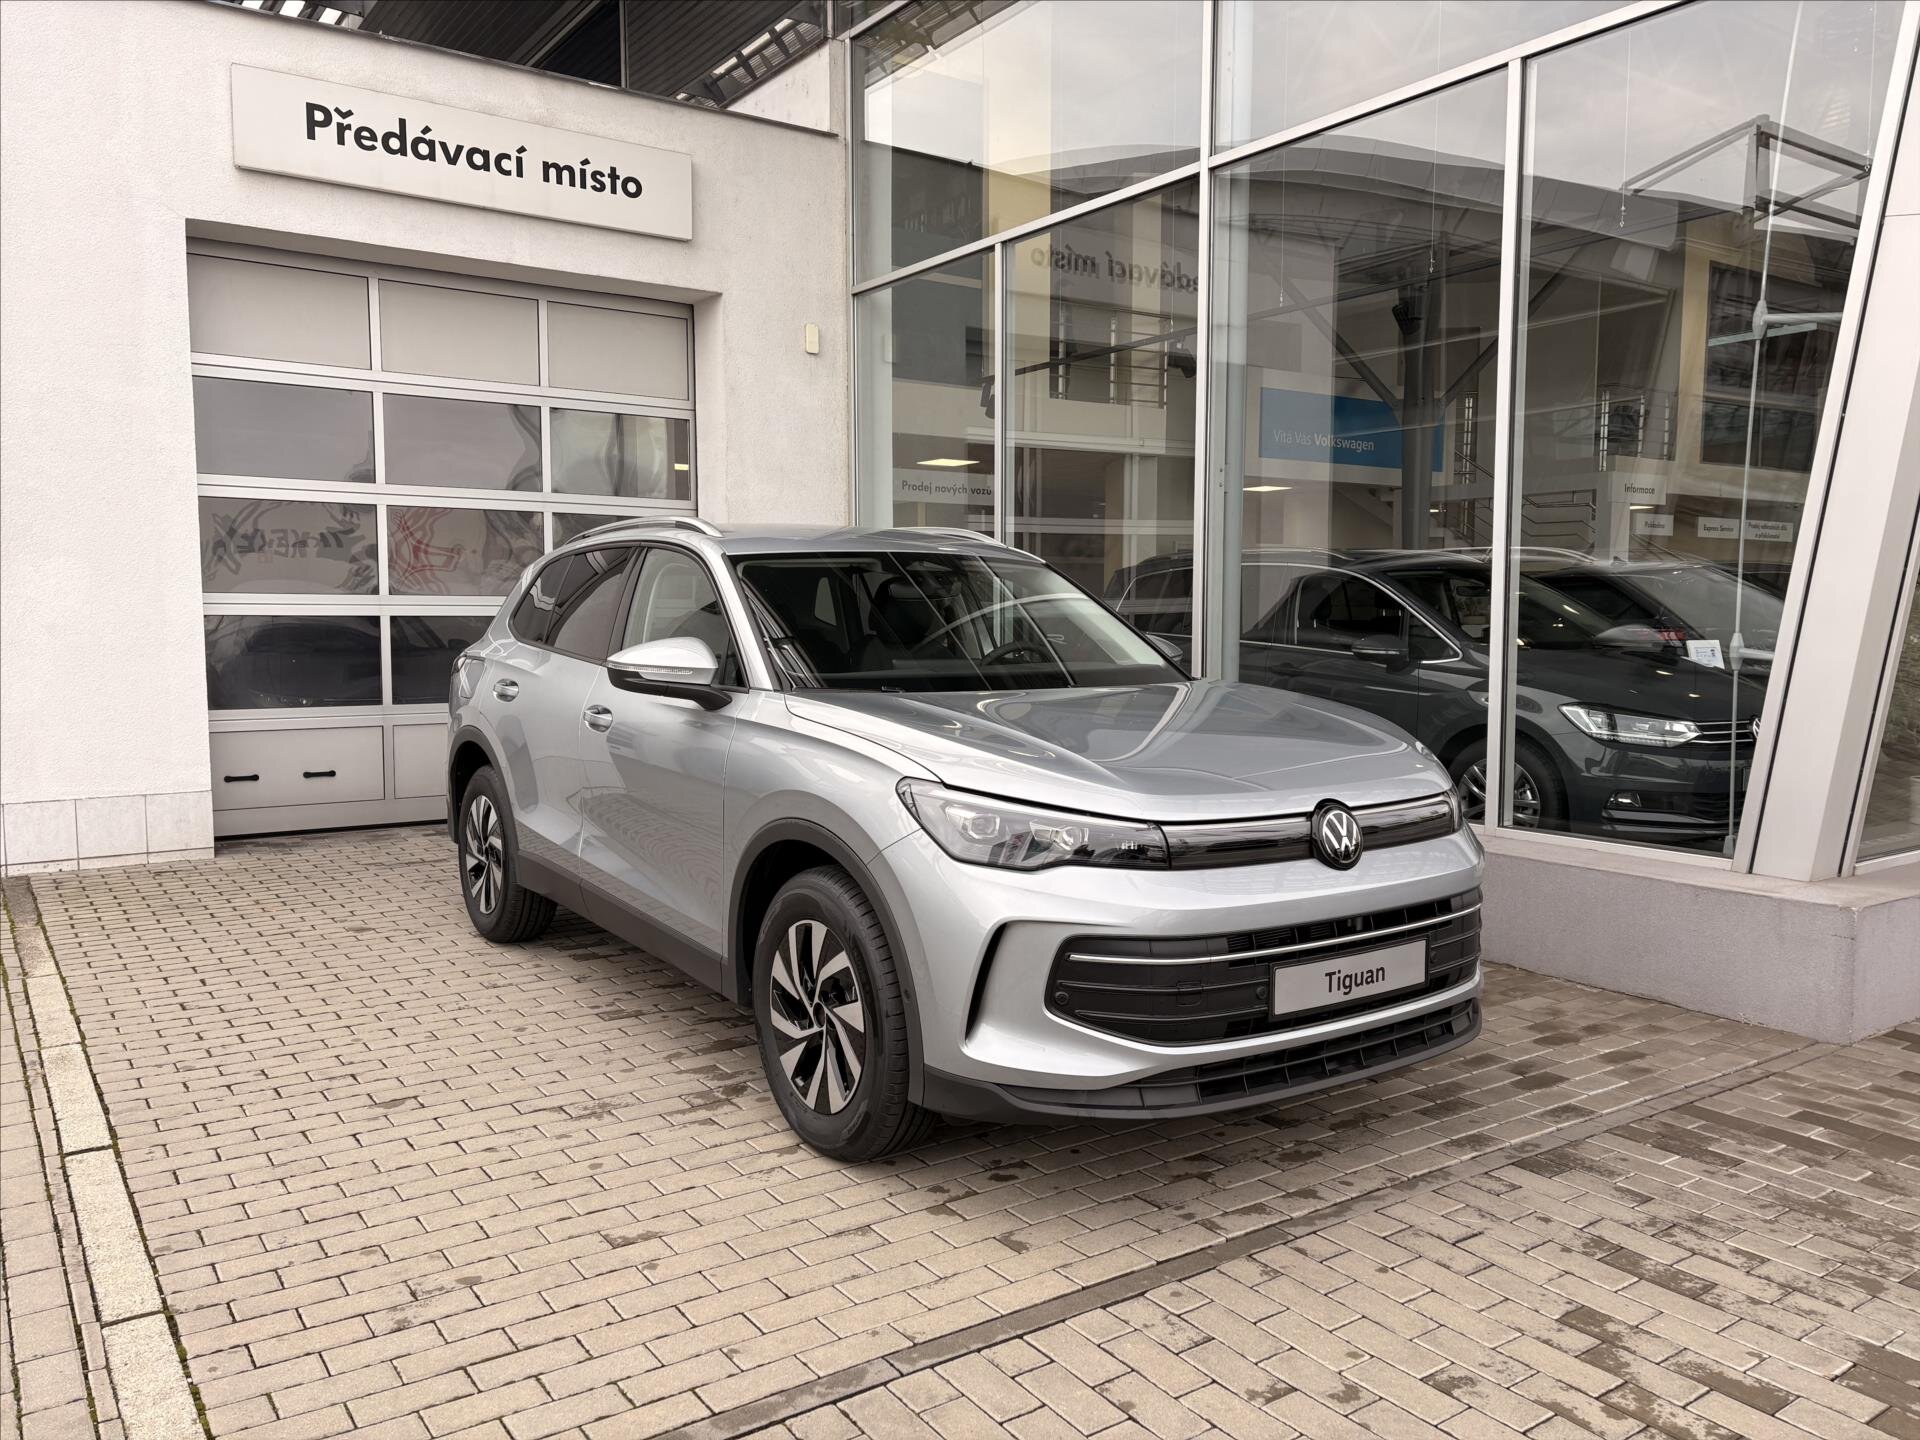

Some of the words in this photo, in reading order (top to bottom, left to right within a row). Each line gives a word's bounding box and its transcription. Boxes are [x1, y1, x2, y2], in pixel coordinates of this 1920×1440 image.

[305, 101, 527, 179] Předávací
[542, 158, 643, 199] místo
[1314, 432, 1375, 453] Volkswagen
[901, 480, 932, 495] Prodej
[935, 482, 967, 496] nových
[1624, 483, 1656, 495] Informace
[1325, 966, 1385, 995] Tiguan
